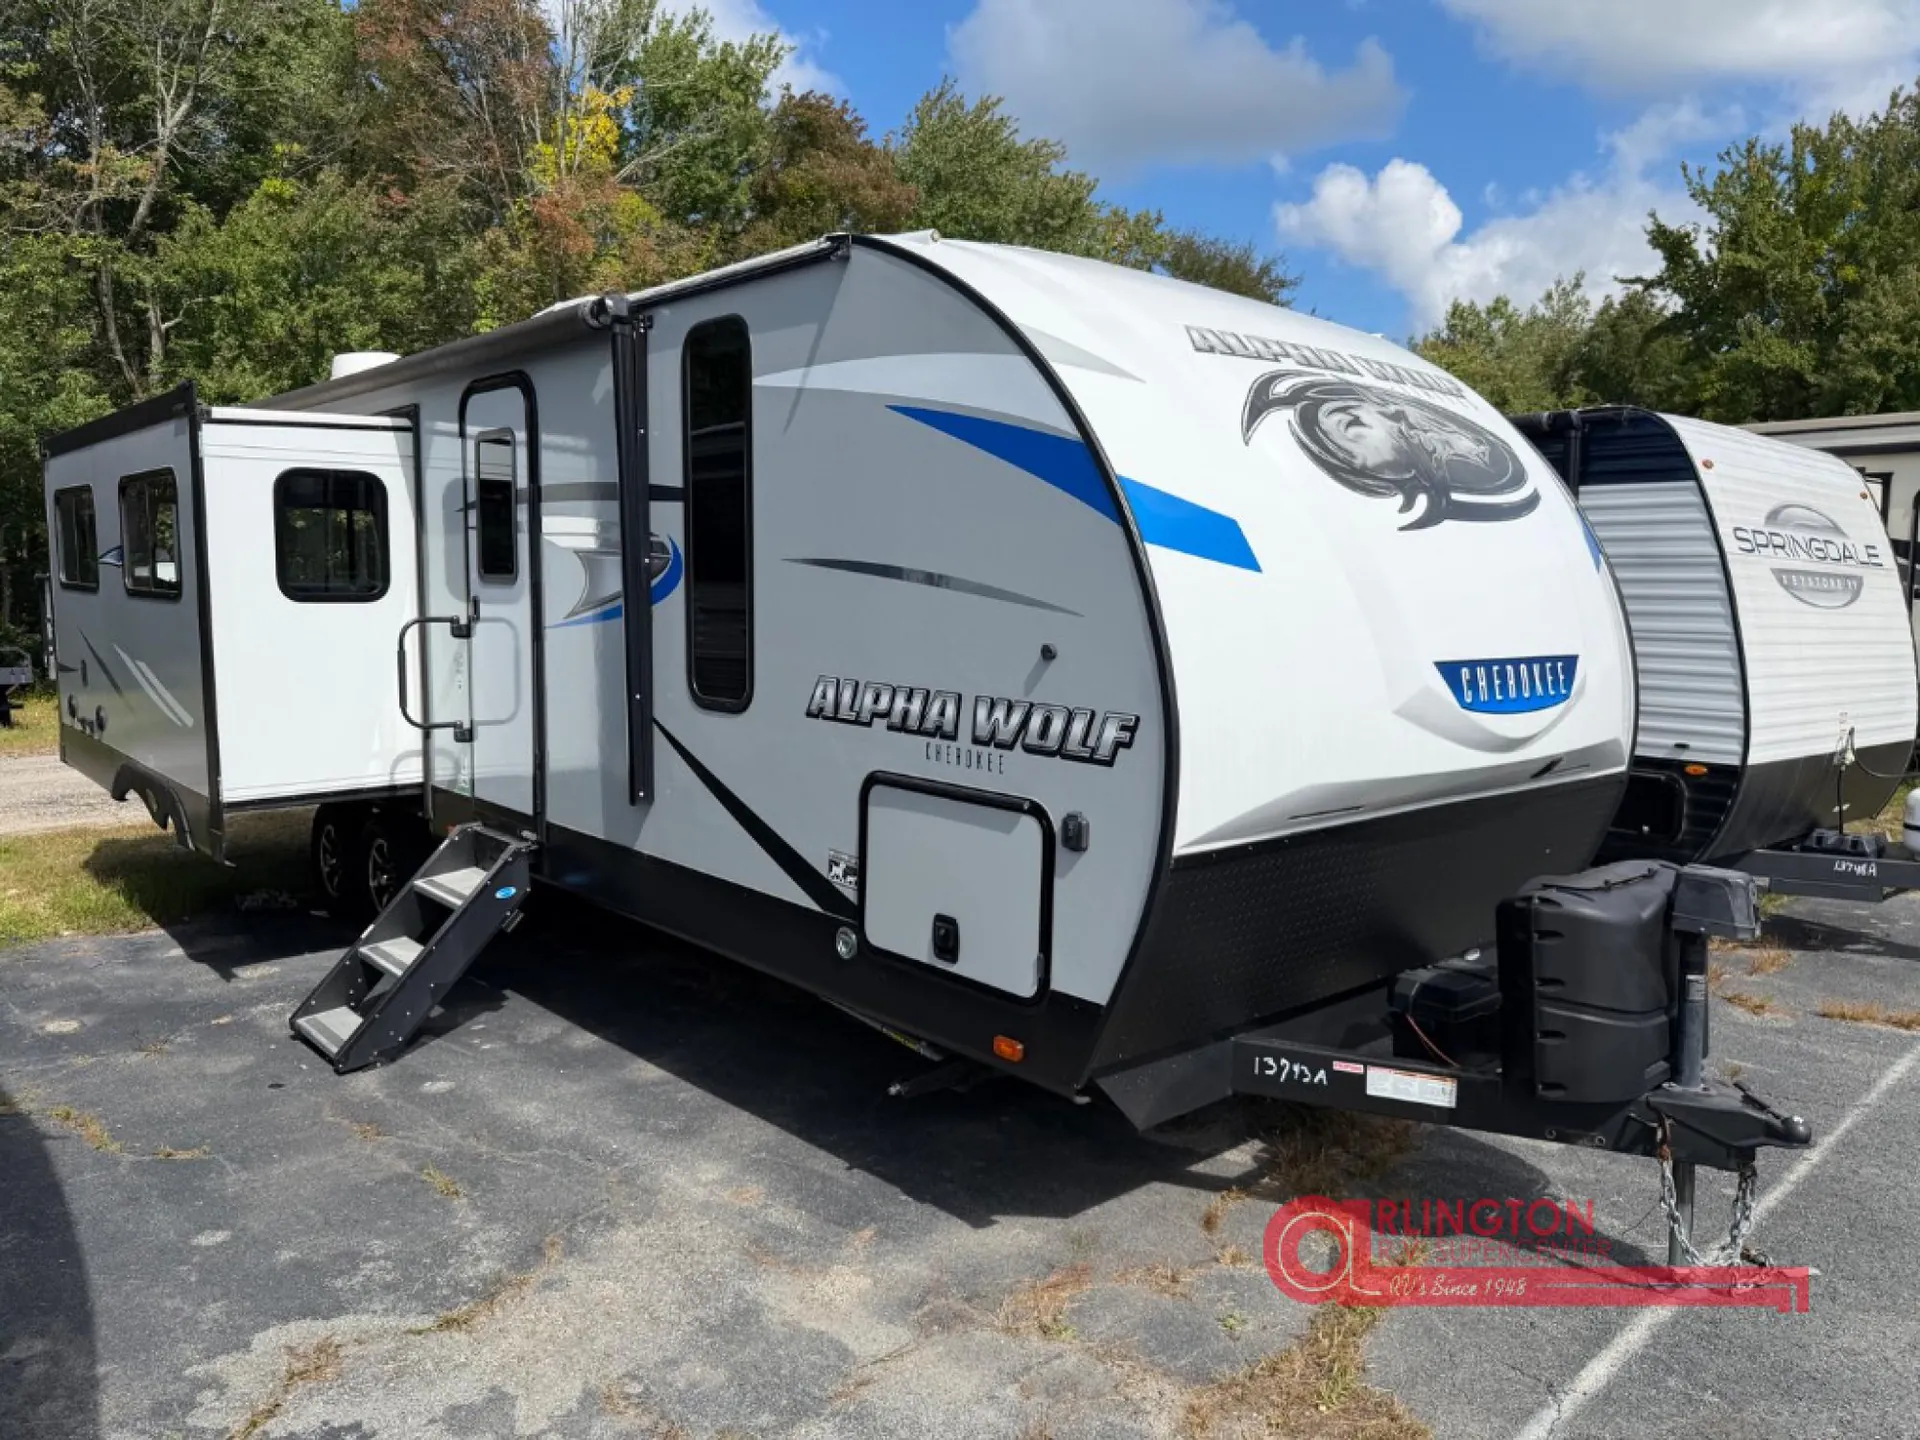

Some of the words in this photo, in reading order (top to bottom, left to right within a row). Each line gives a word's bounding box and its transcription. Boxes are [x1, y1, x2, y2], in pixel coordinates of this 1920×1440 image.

[1733, 526, 1884, 567] SPRINGDALE
[1460, 661, 1568, 703] CHEROKEE
[805, 674, 962, 741] ALPHA
[971, 695, 1141, 768] WOLF
[925, 741, 1006, 775] CHEROKEE
